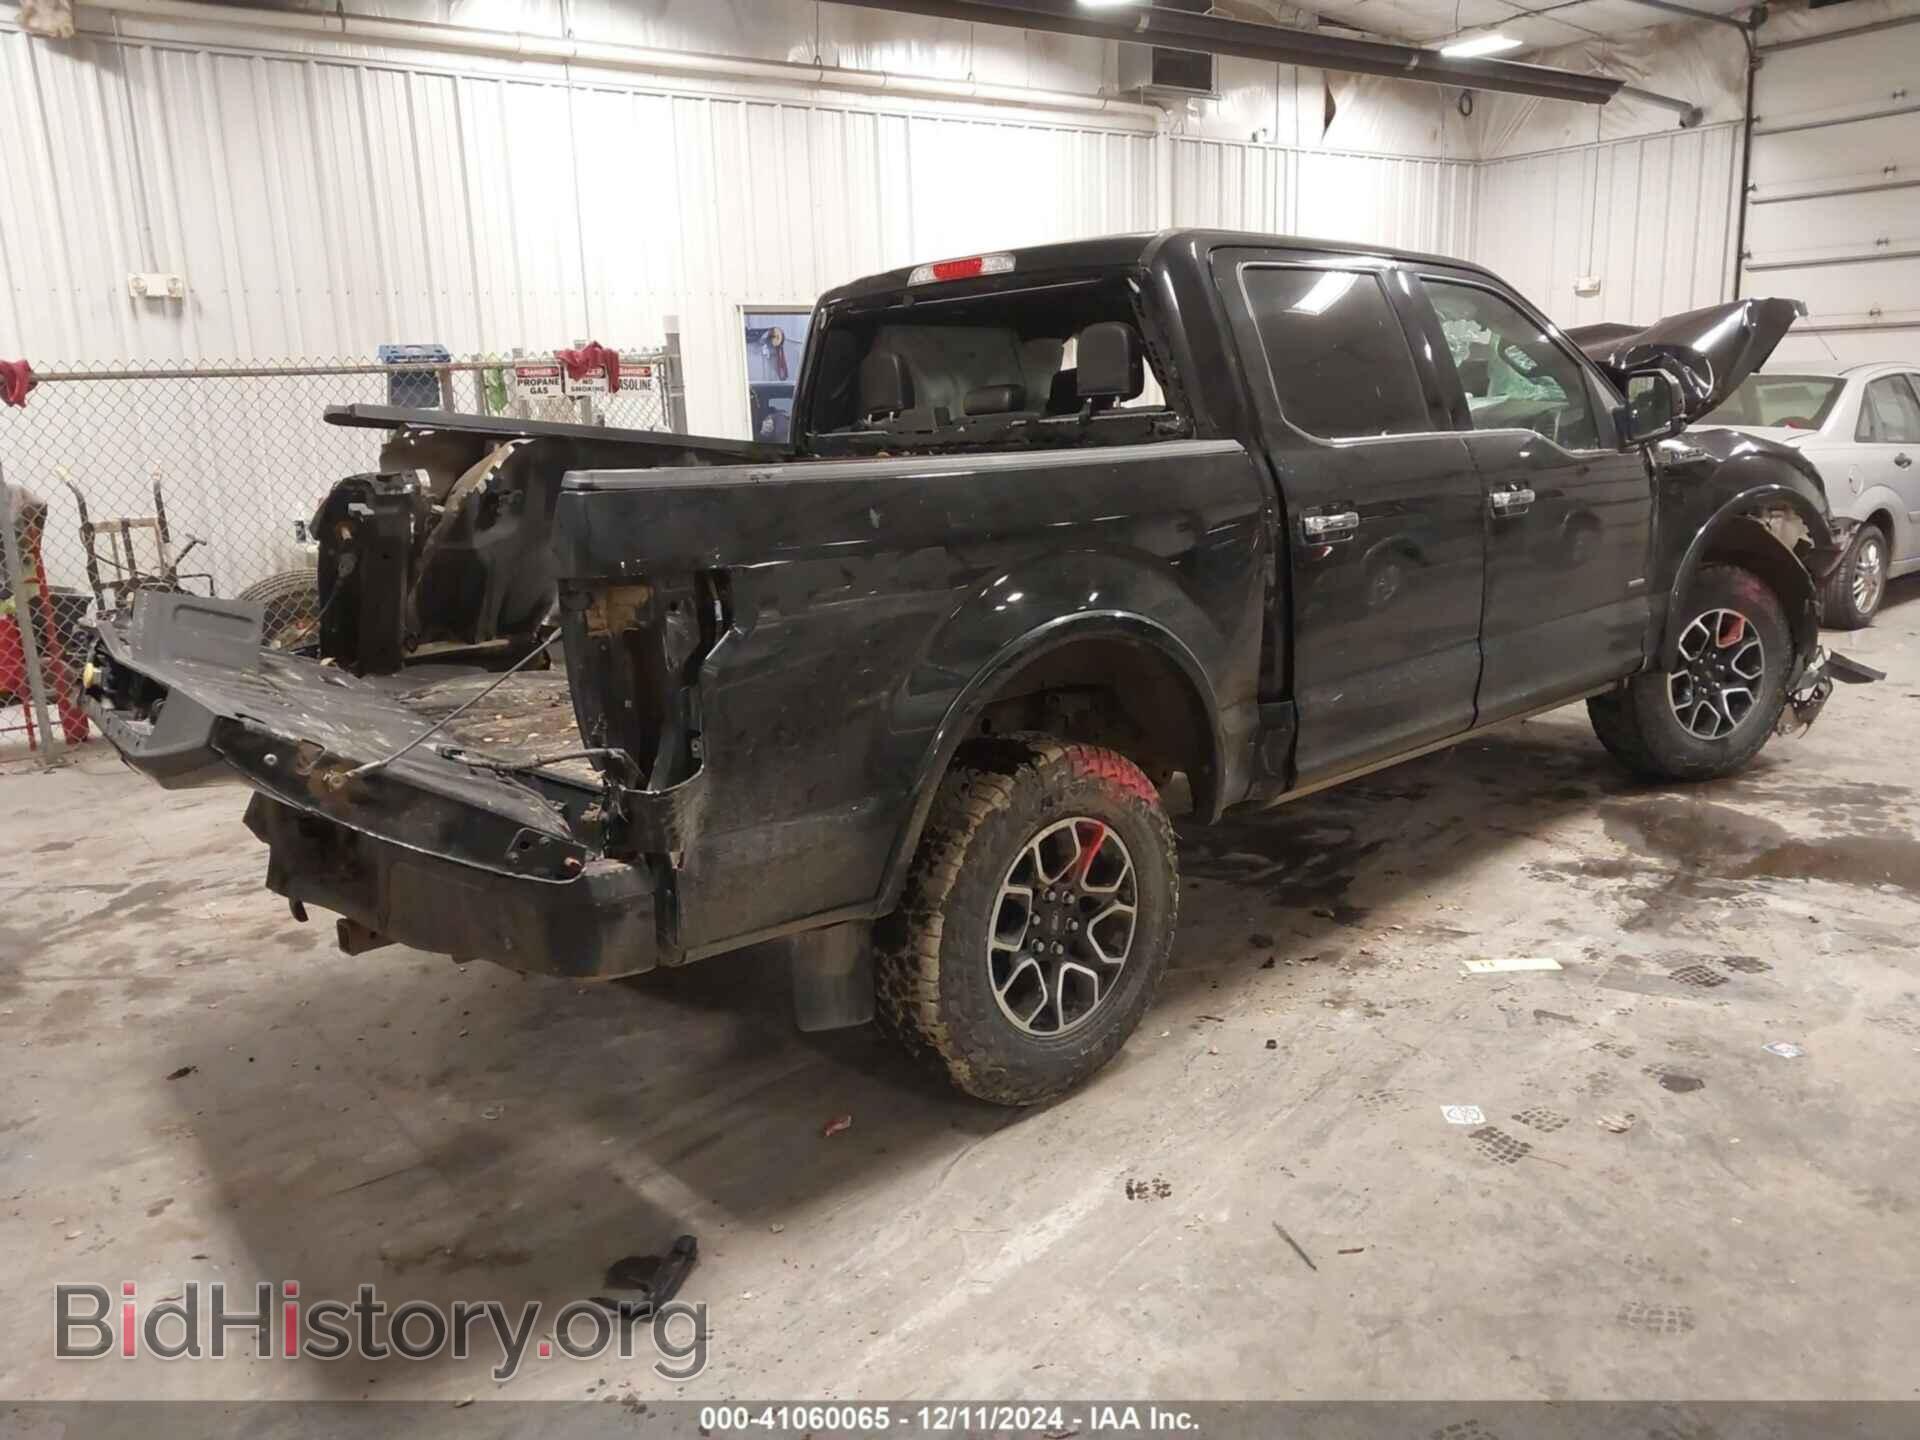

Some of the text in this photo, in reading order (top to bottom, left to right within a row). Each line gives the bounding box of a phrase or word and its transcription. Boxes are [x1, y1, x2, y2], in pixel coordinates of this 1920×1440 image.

[517, 378, 560, 387] PROPANE
[618, 379, 652, 391] ASOLINE
[529, 387, 549, 395] GAS
